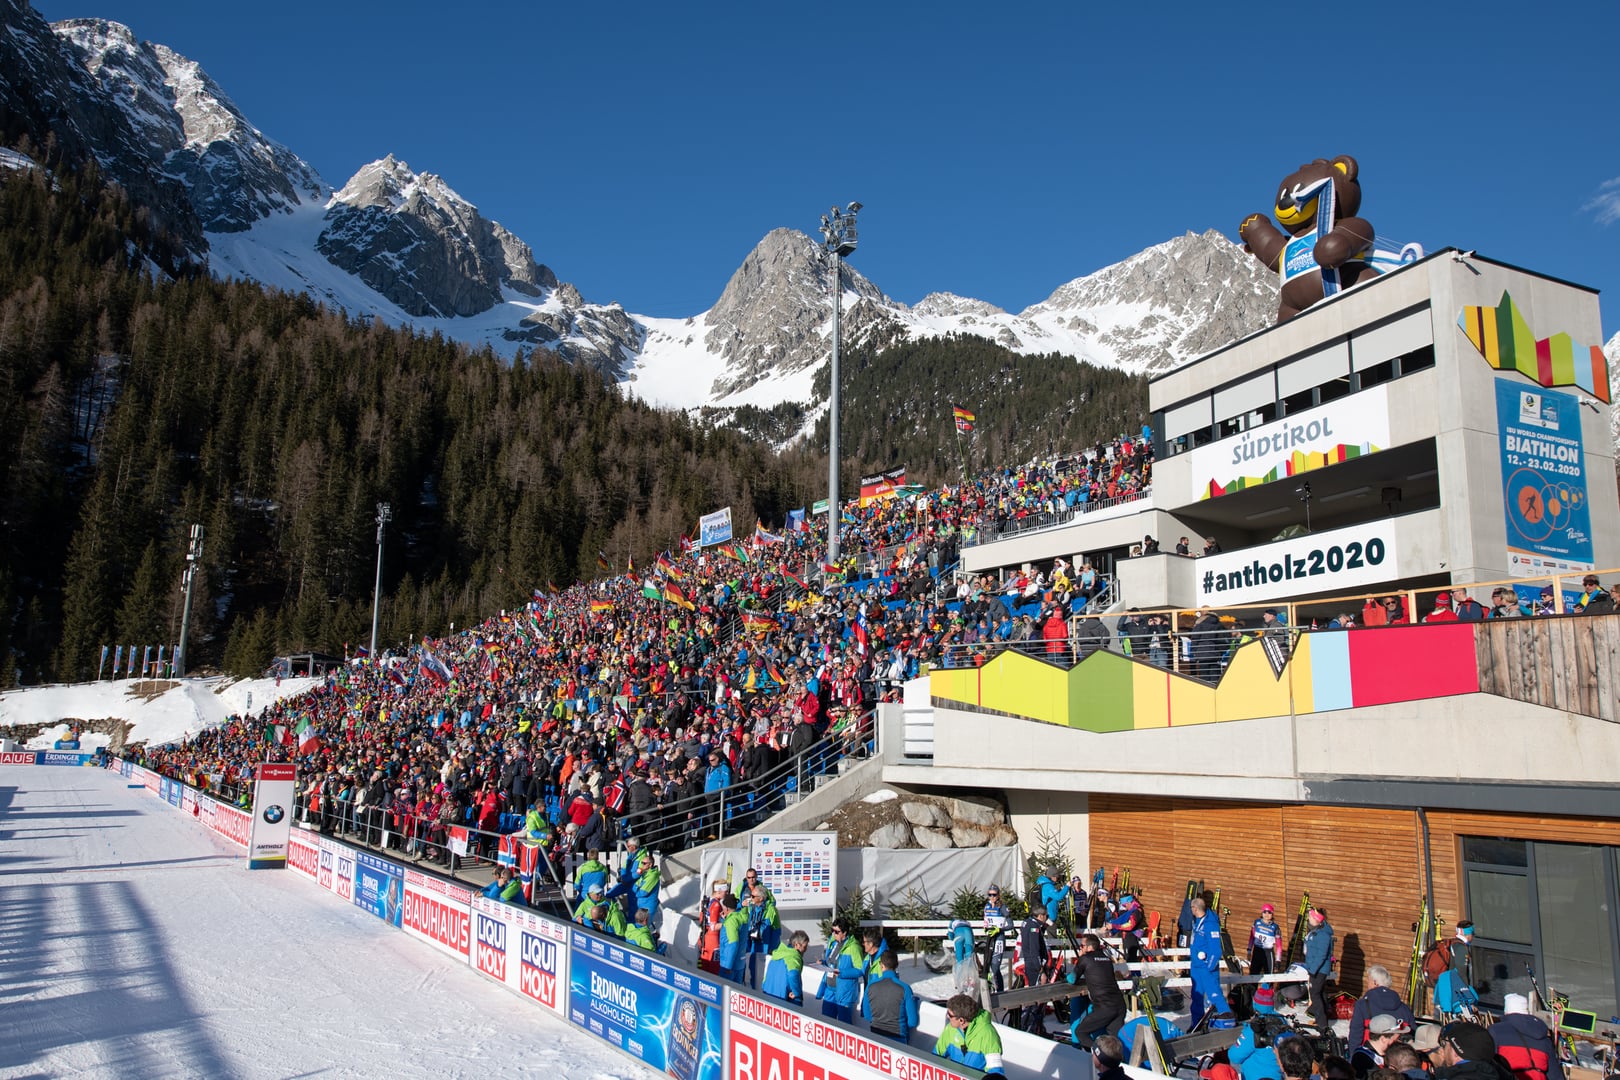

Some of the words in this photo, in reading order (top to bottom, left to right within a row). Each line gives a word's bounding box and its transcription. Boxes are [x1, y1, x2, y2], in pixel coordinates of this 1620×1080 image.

[1506, 435, 1579, 464] BIATHLON
[1203, 537, 1385, 594] #antholz2020
[288, 842, 318, 873] BAUHAUS
[405, 894, 469, 948] BAUHAUS
[478, 915, 505, 951] LIQUI
[478, 943, 505, 979] MOLY
[522, 933, 555, 972] LIQUI
[522, 964, 556, 1004] MOLY
[591, 971, 638, 1016] ERDINGER
[590, 998, 637, 1028] ALKOHOLFREI
[740, 996, 801, 1038] BAUHAUS
[672, 1023, 698, 1063] ERDINGER
[815, 1027, 891, 1073] BAUHAUS
